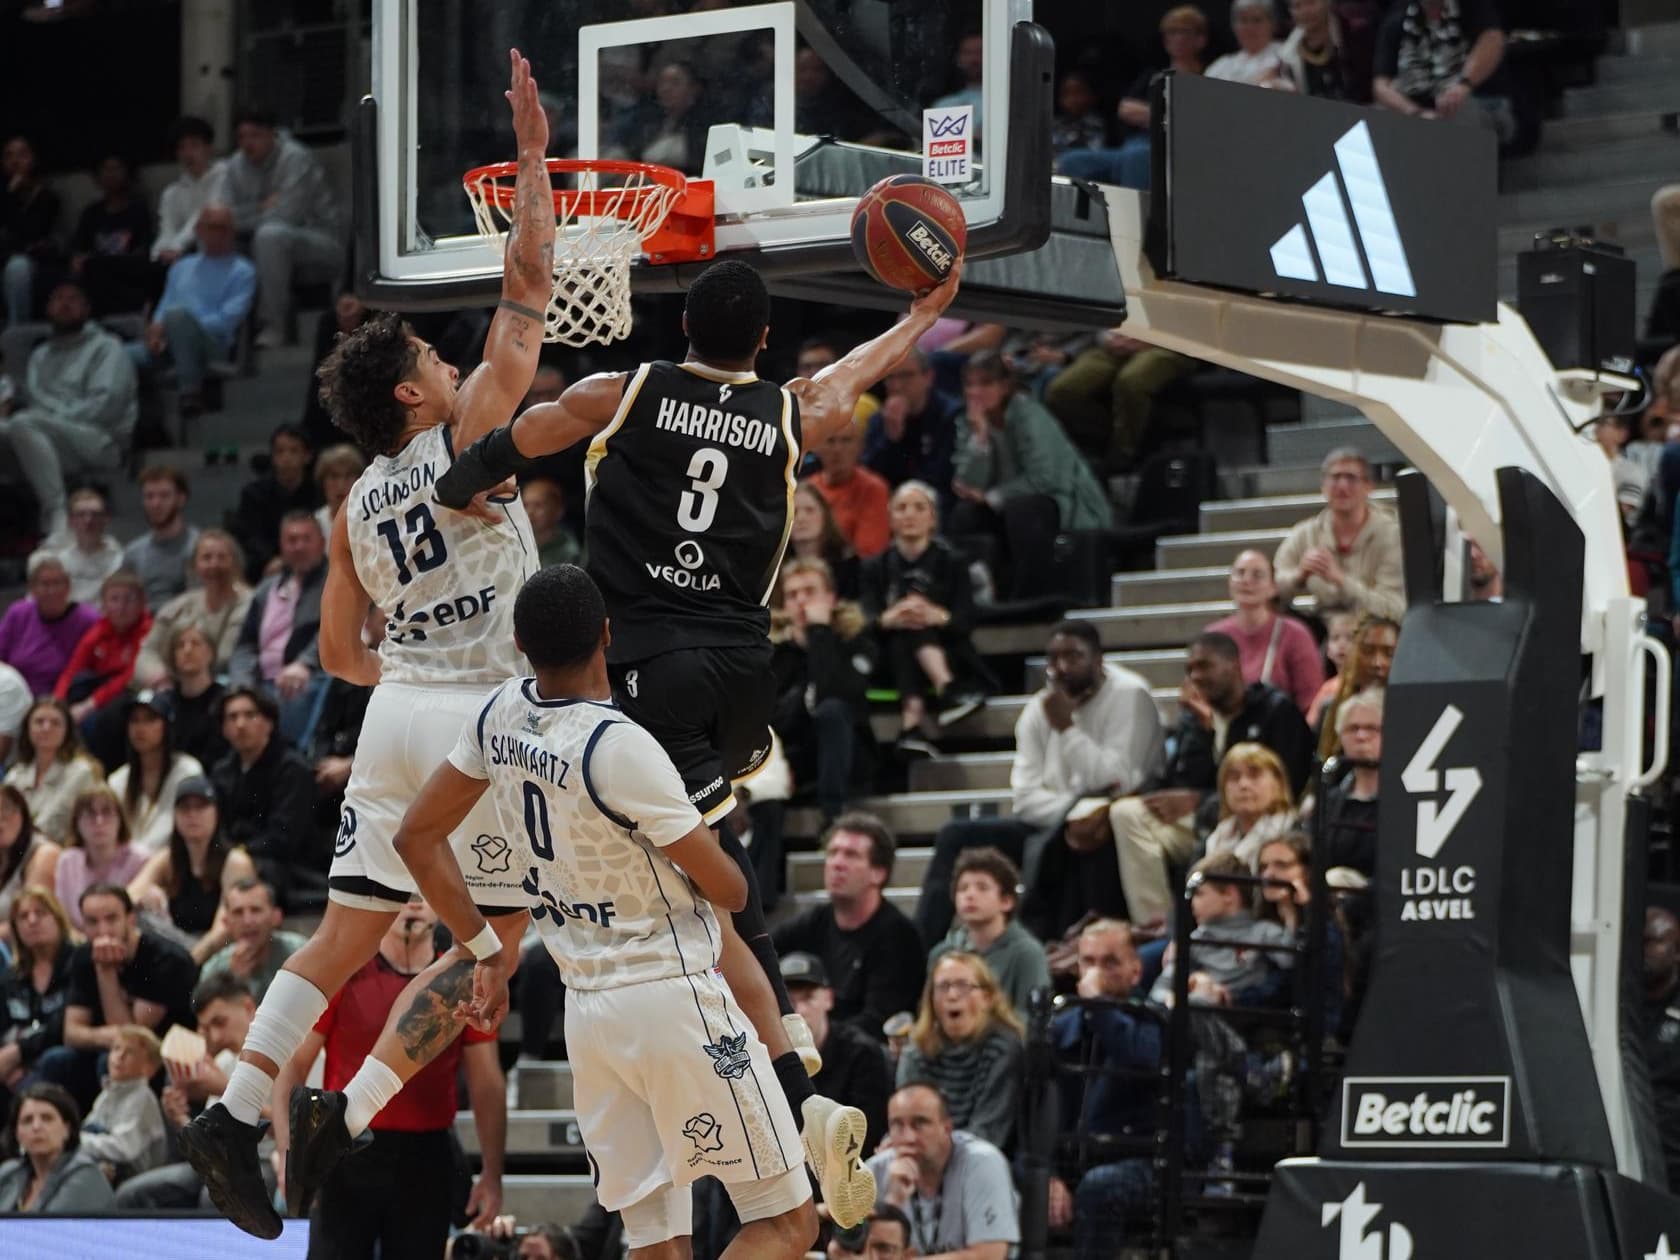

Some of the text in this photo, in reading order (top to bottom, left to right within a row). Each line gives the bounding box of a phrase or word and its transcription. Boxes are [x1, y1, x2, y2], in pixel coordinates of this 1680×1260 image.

[928, 159, 966, 177] ÉLITE
[931, 143, 964, 155] Betclic
[909, 226, 951, 271] Betclic
[655, 397, 778, 457] HARRISON
[677, 447, 729, 533] 3
[377, 502, 447, 586] 13
[645, 562, 721, 591] VEOLIA
[625, 669, 639, 699] 3
[491, 735, 570, 790] SCHWARTZ
[523, 780, 555, 862] 0
[1400, 865, 1476, 896] LDLC
[1400, 898, 1476, 921] ASVEL
[1353, 1090, 1497, 1135] Betclic
